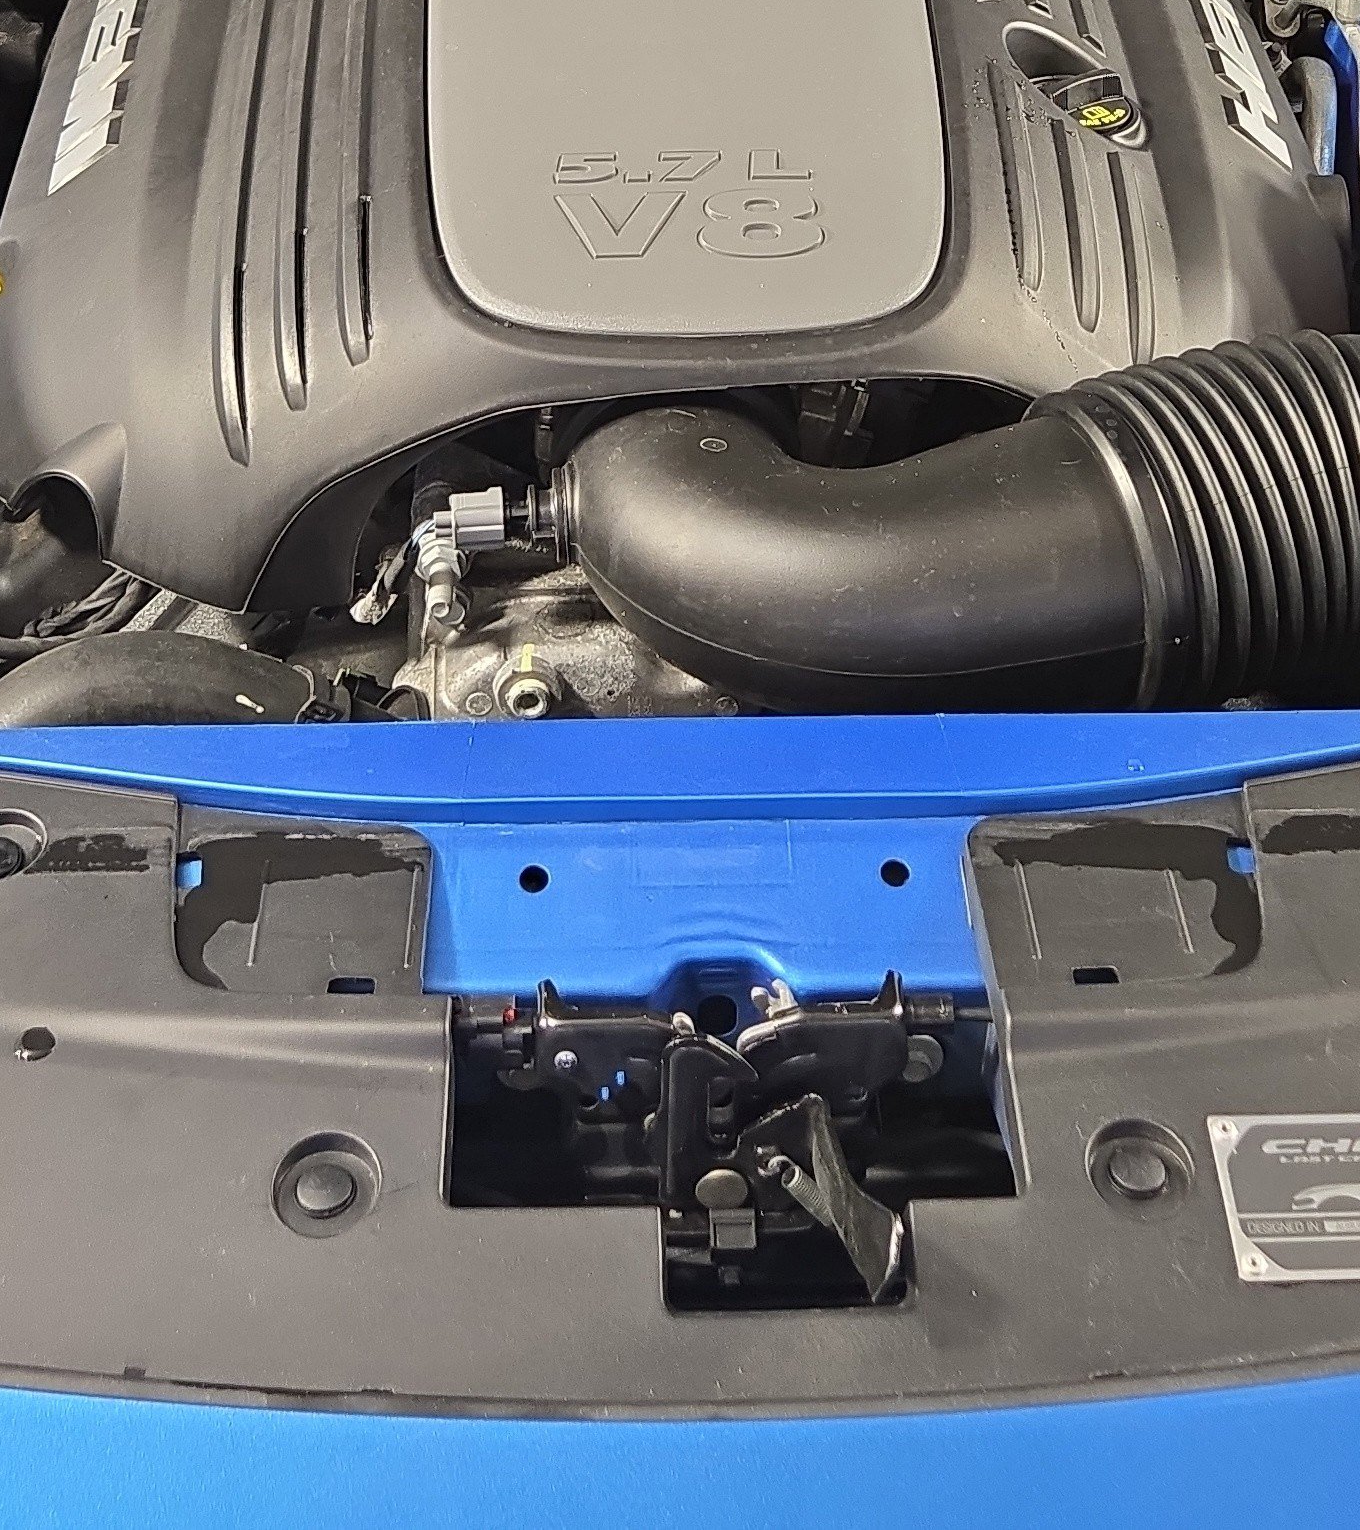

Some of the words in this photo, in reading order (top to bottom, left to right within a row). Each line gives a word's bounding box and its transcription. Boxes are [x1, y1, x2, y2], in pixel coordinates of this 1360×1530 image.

[553, 149, 722, 184] 5.7
[748, 148, 813, 181] L
[553, 187, 826, 260] V8
[1279, 1154, 1333, 1164] LAST
